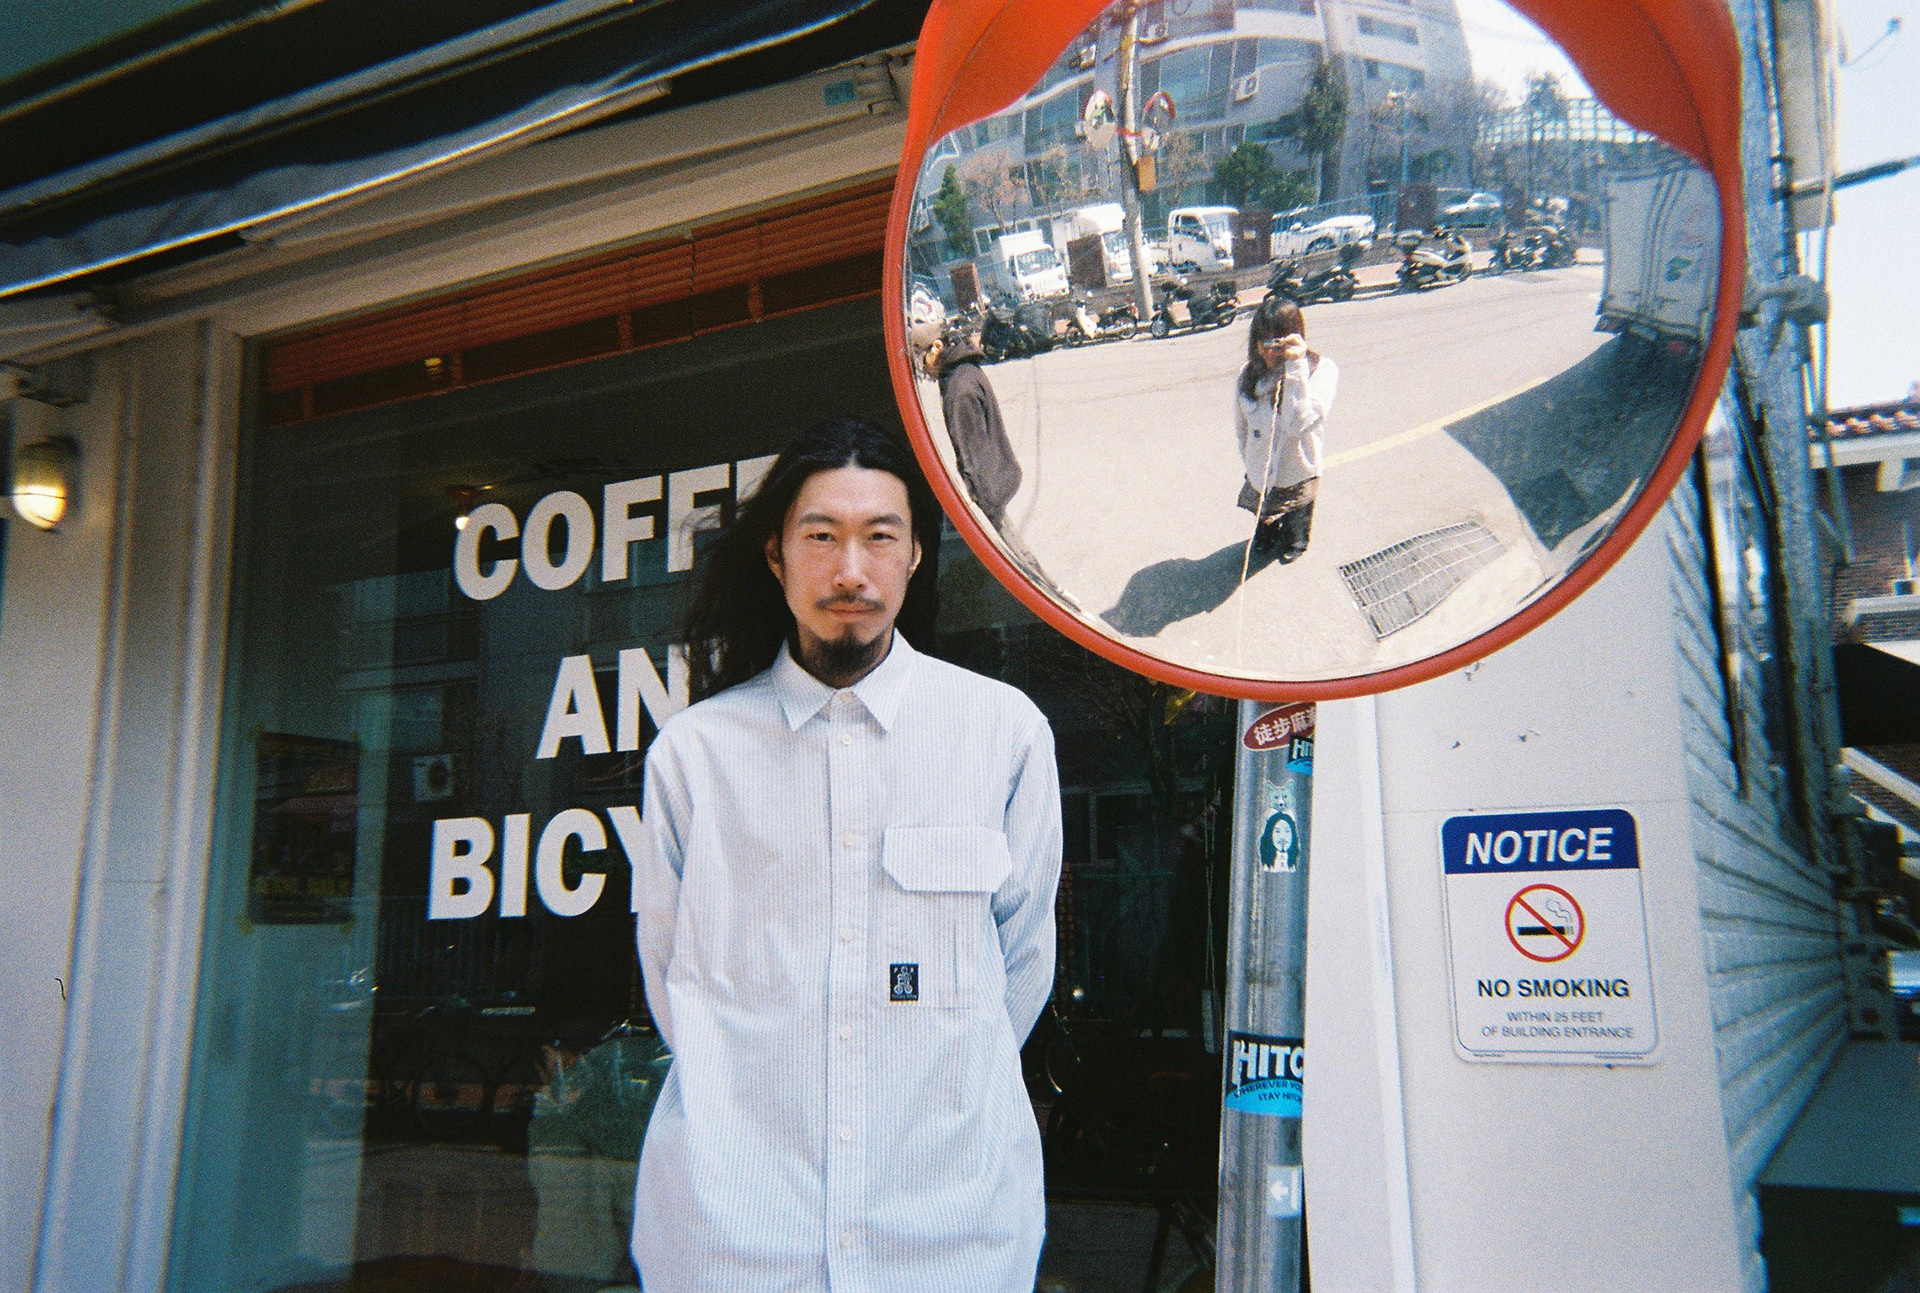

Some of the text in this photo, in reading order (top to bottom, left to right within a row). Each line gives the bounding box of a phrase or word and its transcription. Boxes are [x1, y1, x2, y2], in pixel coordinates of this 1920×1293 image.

[535, 640, 727, 759] AN
[1465, 827, 1614, 866] NOTICE
[1477, 978, 1631, 998] NO SMOKING
[1507, 1011, 1603, 1023] WITHIN 25 FEET
[1481, 1026, 1635, 1039] OF BUILDING ENTRANCE
